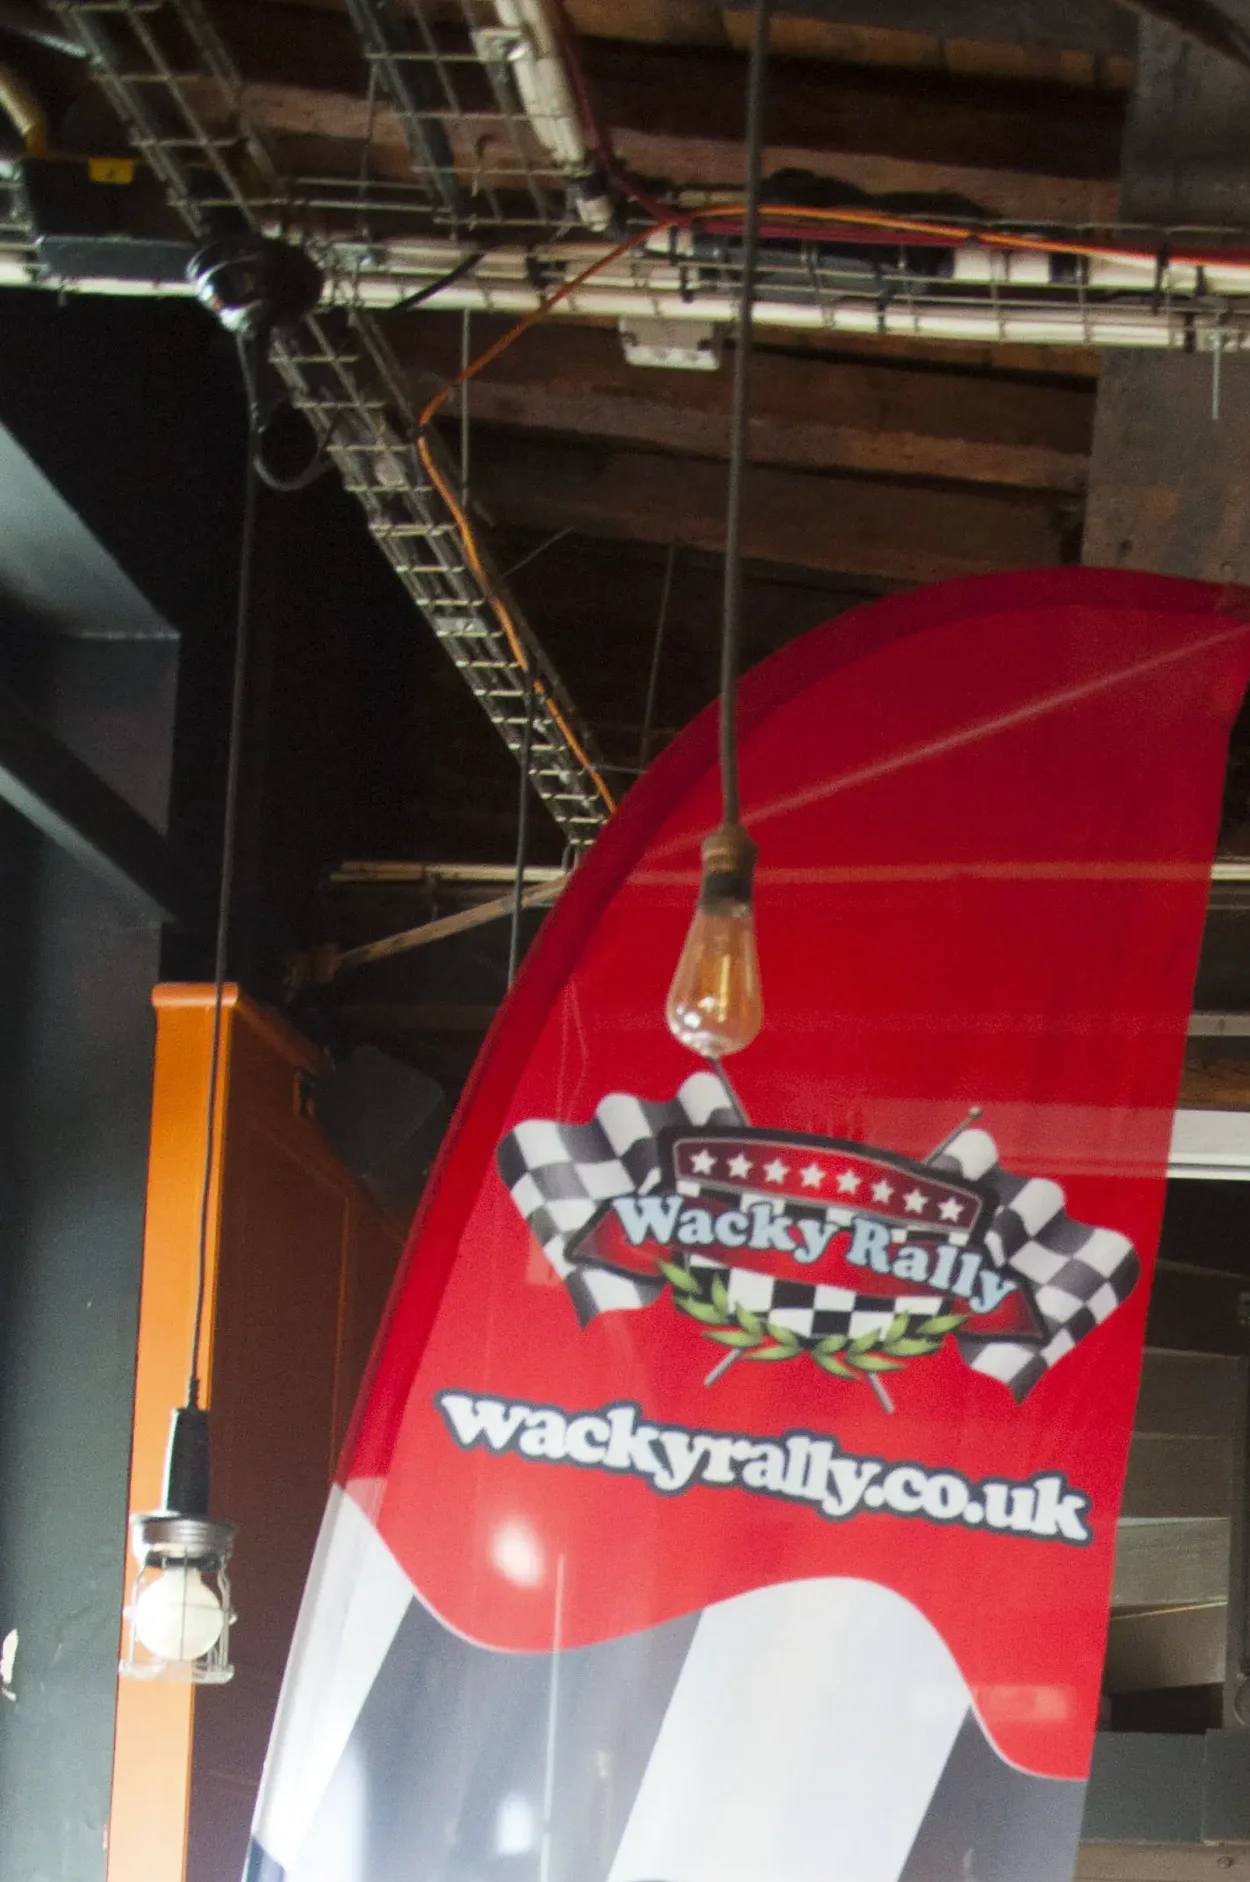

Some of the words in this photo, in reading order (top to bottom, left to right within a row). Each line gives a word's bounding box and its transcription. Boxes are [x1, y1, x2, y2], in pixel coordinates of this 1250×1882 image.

[612, 1193, 840, 1264] Wacky
[845, 1215, 1017, 1315] Rally
[438, 1392, 1091, 1543] wackyrally.co.uk
